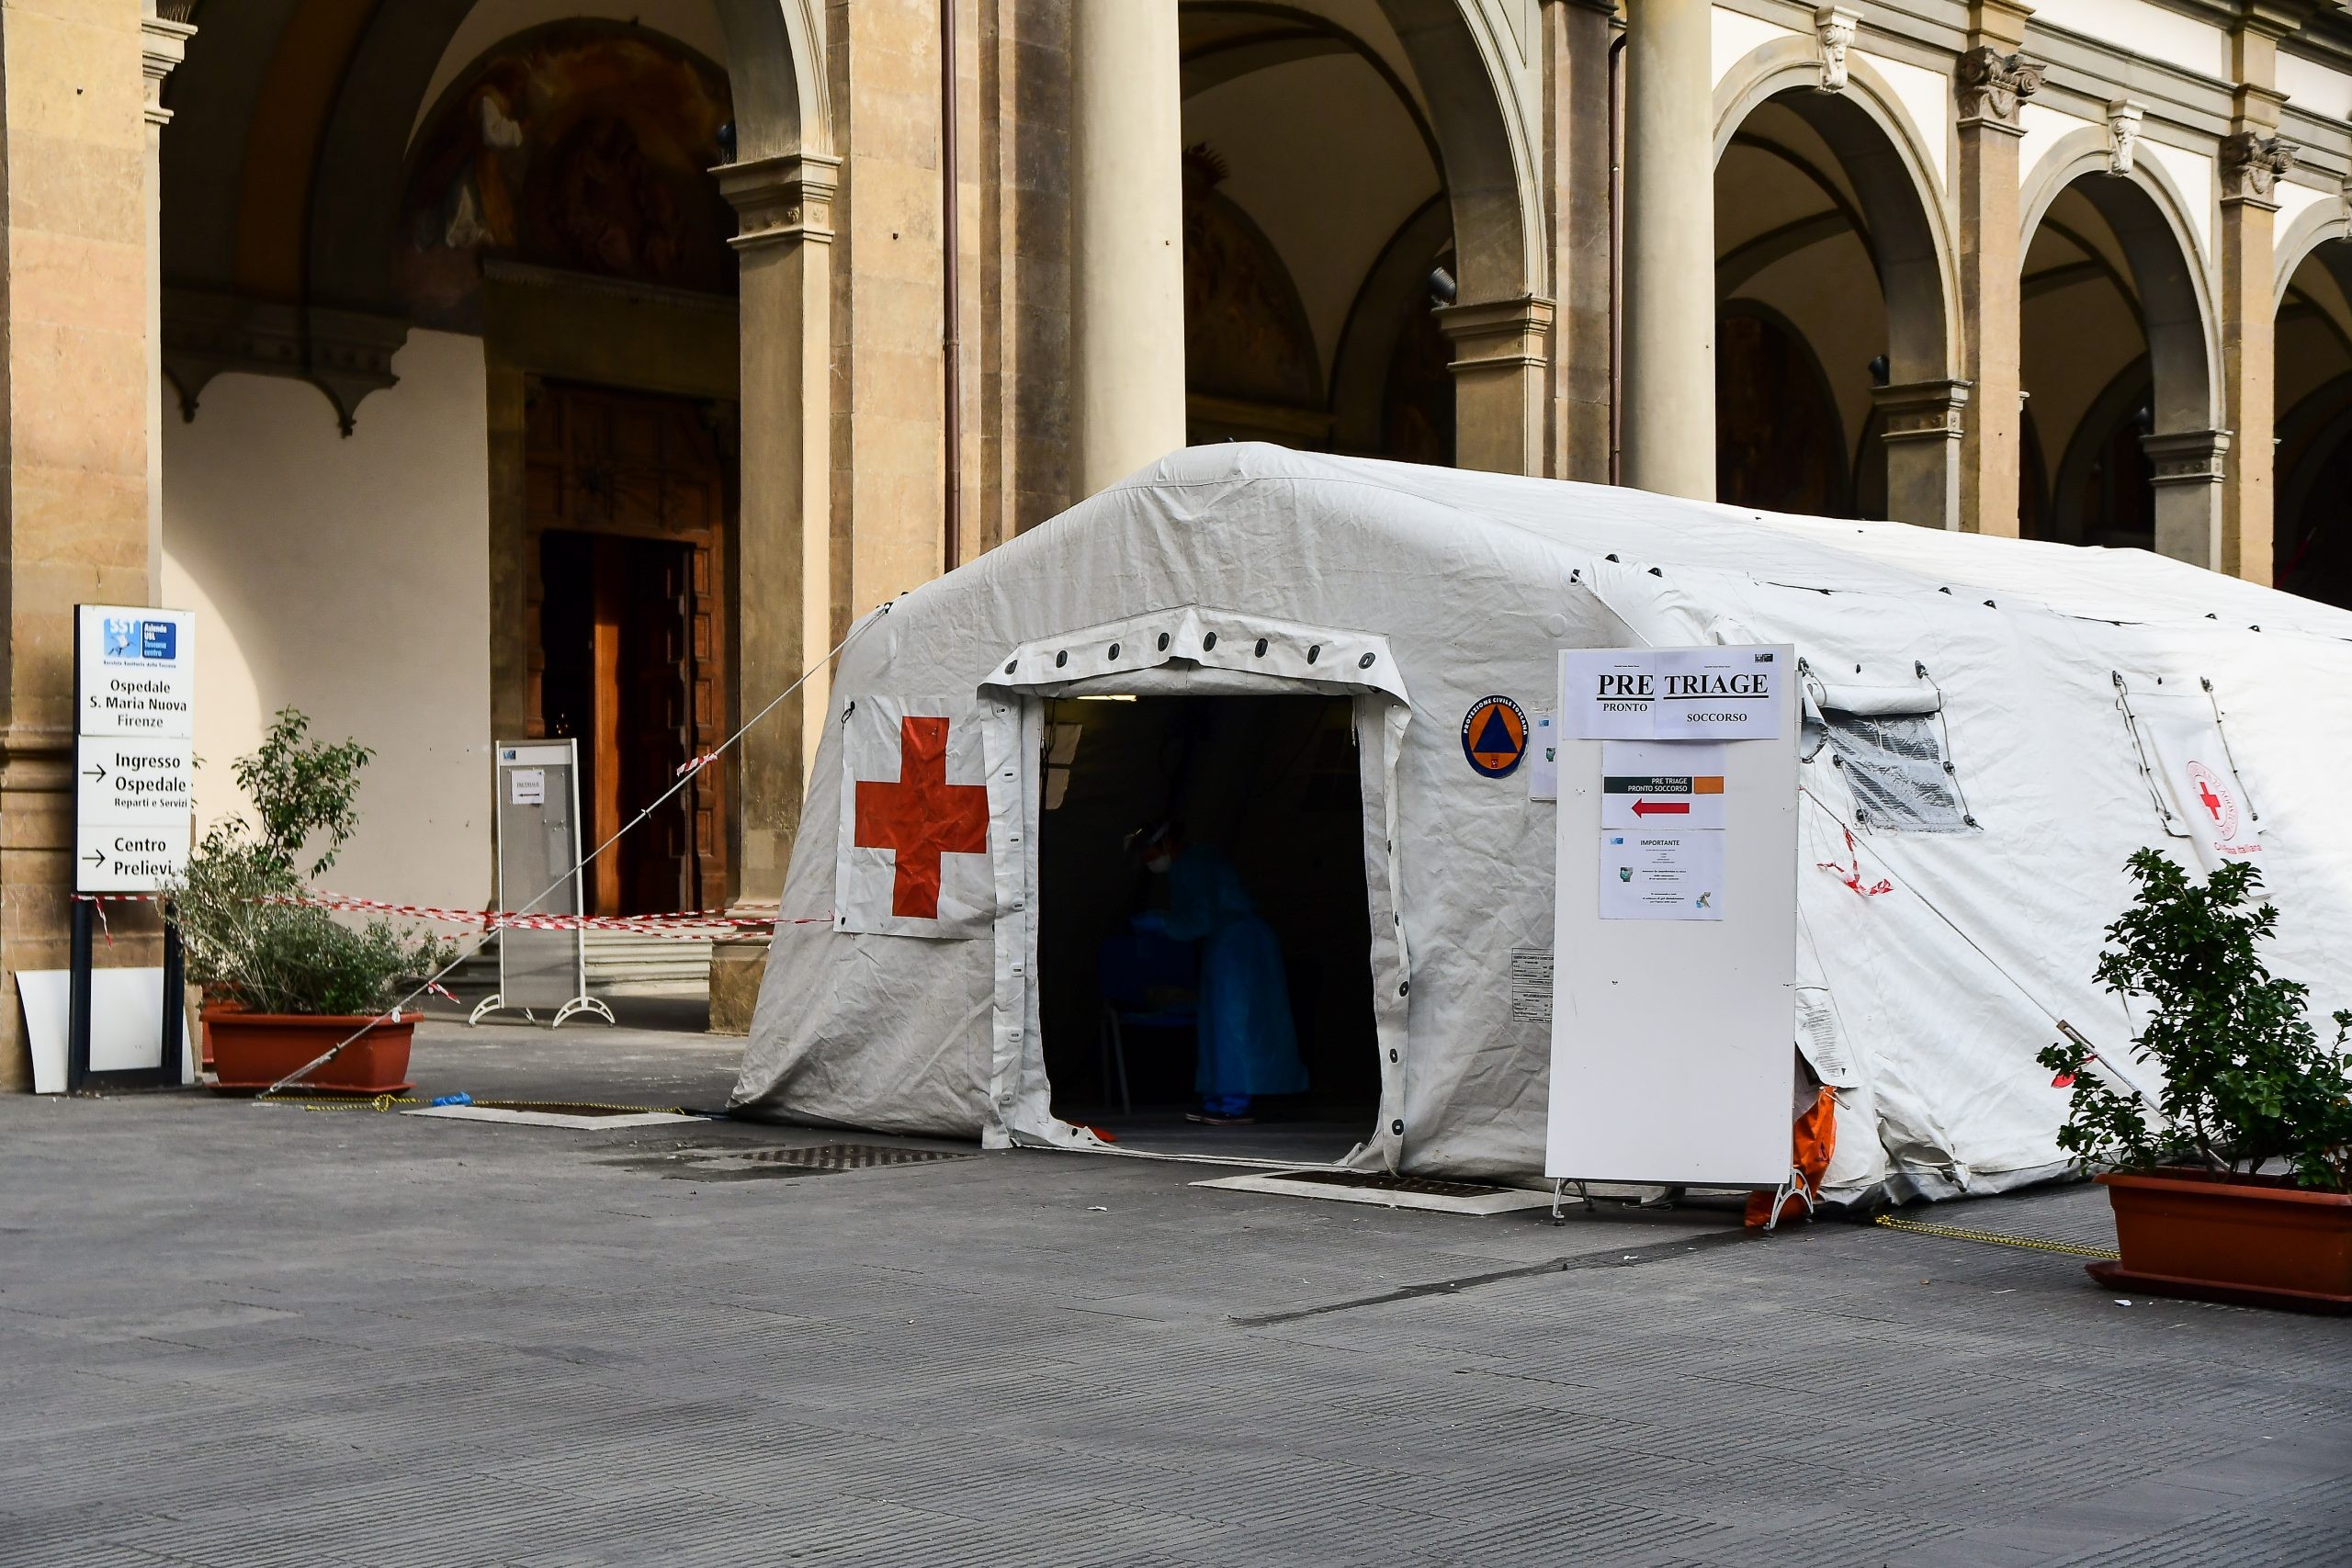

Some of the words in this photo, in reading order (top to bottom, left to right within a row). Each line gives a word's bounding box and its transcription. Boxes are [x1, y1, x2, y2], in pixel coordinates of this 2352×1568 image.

[110, 679, 171, 694] Ospedale
[1597, 674, 1655, 695] PRE
[1664, 674, 1769, 695] TRIAGE
[90, 695, 102, 708] S.
[106, 696, 144, 709] Maria
[149, 698, 187, 712] Nuova
[1602, 703, 1648, 712] PRONTO
[118, 714, 164, 728] Firenze
[1463, 698, 1492, 734] PROTEZIONE
[1492, 697, 1512, 707] CIVILE
[1511, 704, 1528, 736] TOSCANA
[1687, 713, 1747, 723] SOCCORSO
[115, 752, 181, 772] Ingresso
[115, 776, 187, 795] Ospedale
[114, 798, 149, 809] Reparti
[160, 798, 187, 808] Servizi
[114, 837, 166, 852] Centro
[114, 860, 172, 875] Prelievi
